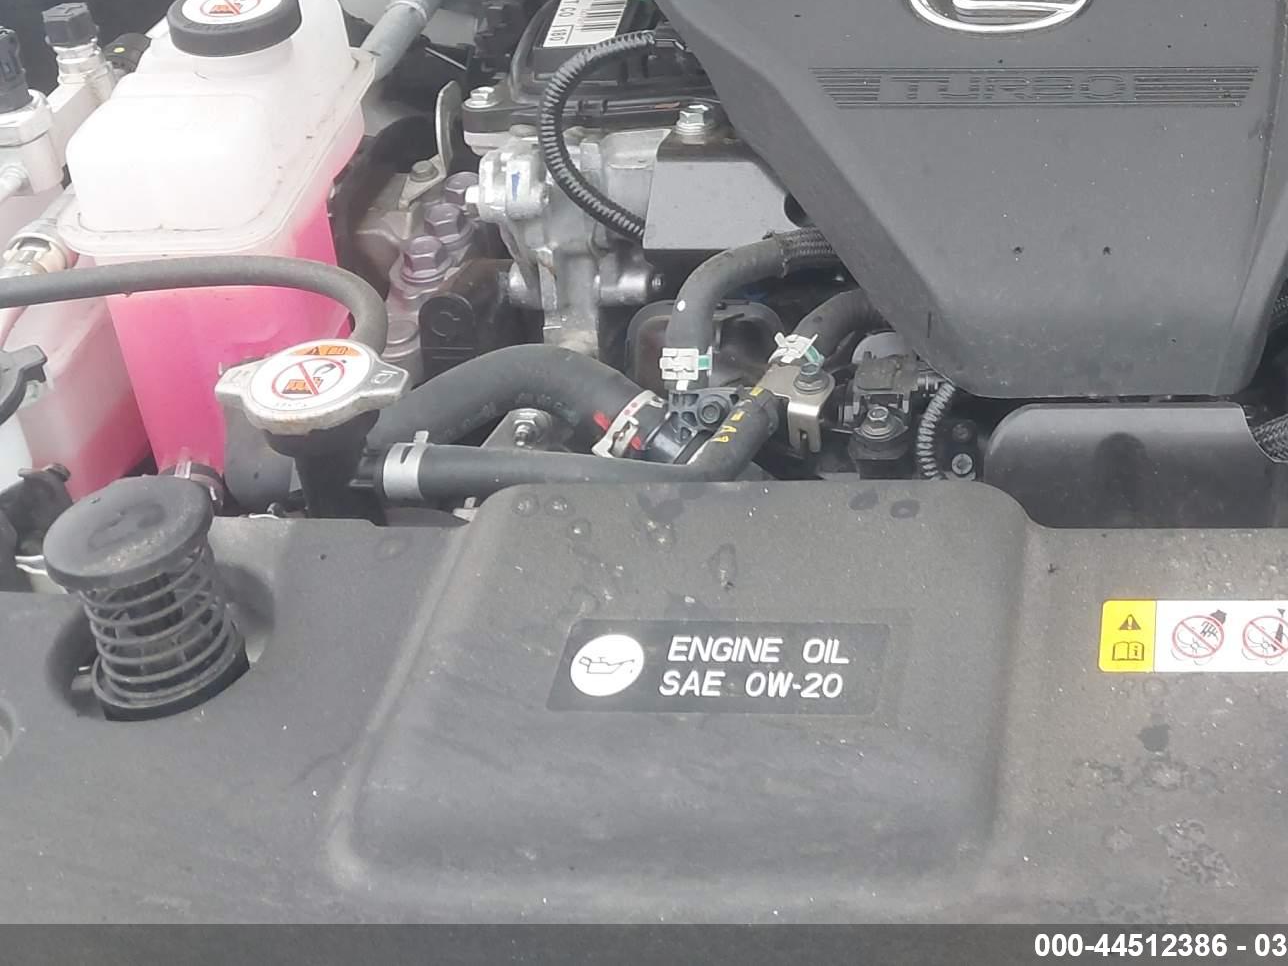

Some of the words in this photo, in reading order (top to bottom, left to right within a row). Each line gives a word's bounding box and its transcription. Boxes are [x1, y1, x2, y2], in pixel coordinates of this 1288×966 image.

[889, 74, 1127, 101] TURBO
[667, 636, 783, 663] ENGINE
[802, 638, 850, 664] OIL
[659, 671, 726, 697] SAE
[745, 672, 844, 699] 0W-20
